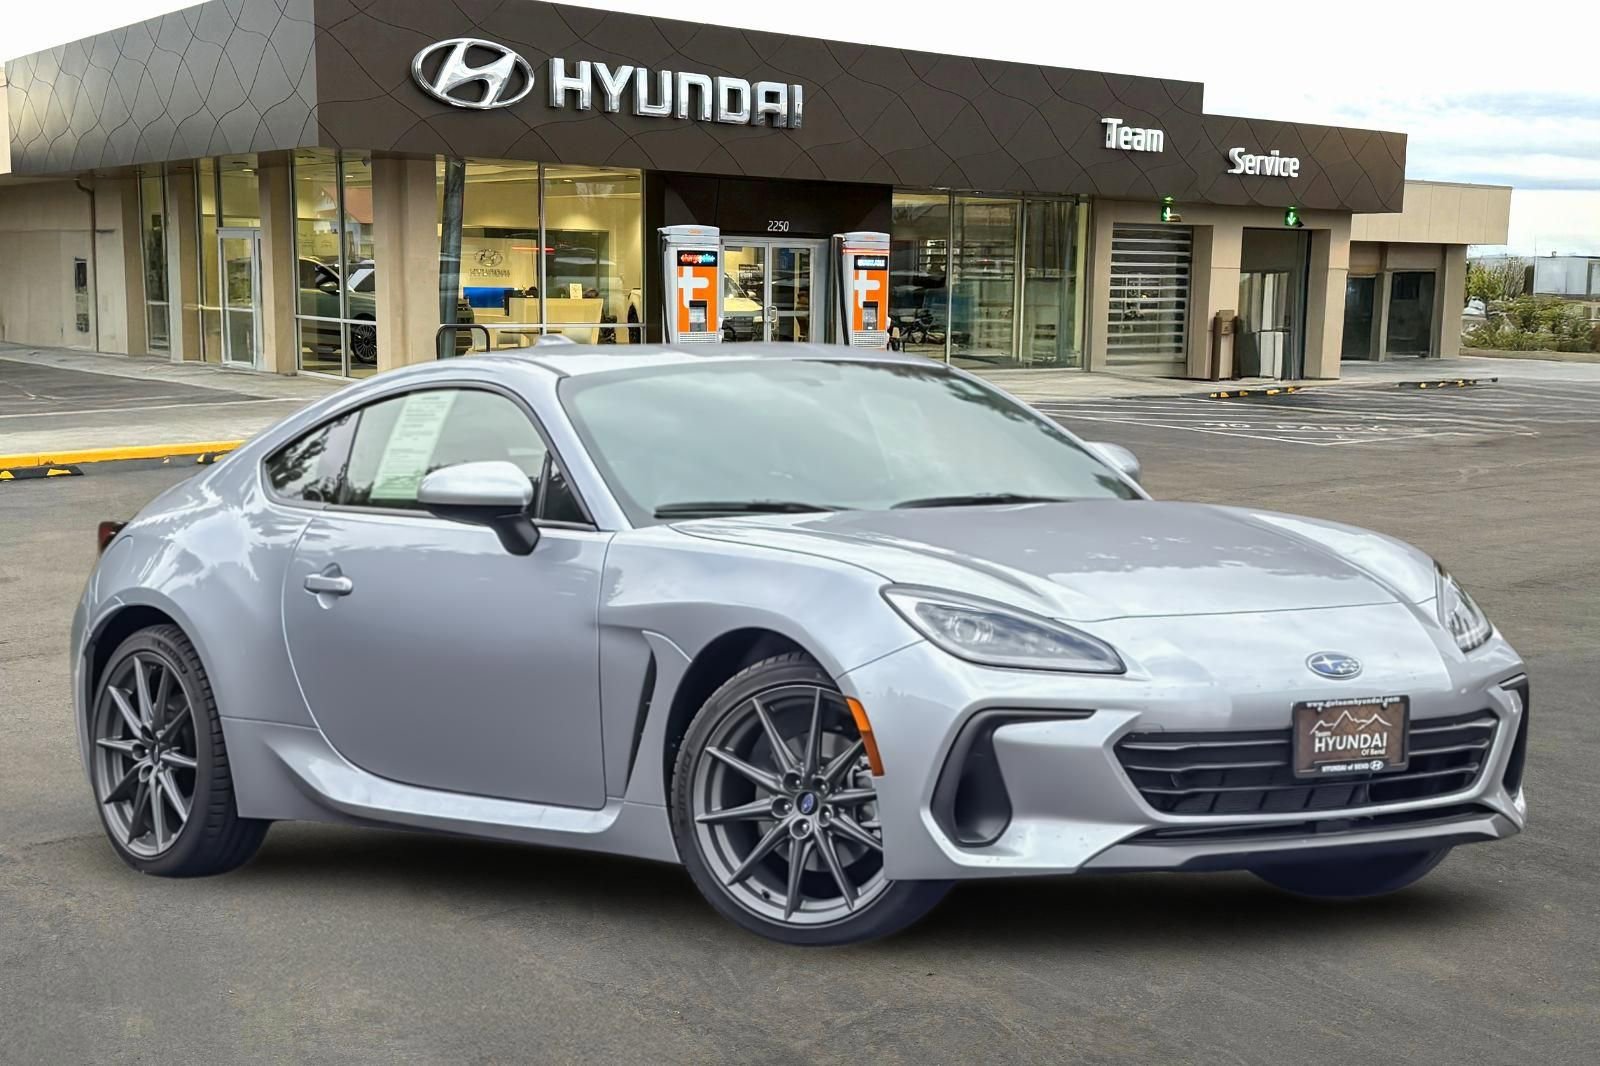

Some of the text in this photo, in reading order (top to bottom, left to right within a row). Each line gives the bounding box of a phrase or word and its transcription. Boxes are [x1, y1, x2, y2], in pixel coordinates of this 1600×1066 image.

[548, 57, 803, 129] HYUNDAI
[1101, 117, 1164, 153] Team
[1227, 147, 1300, 178] Service
[767, 220, 790, 232] 2250
[1314, 731, 1388, 753] HYUNDAI
